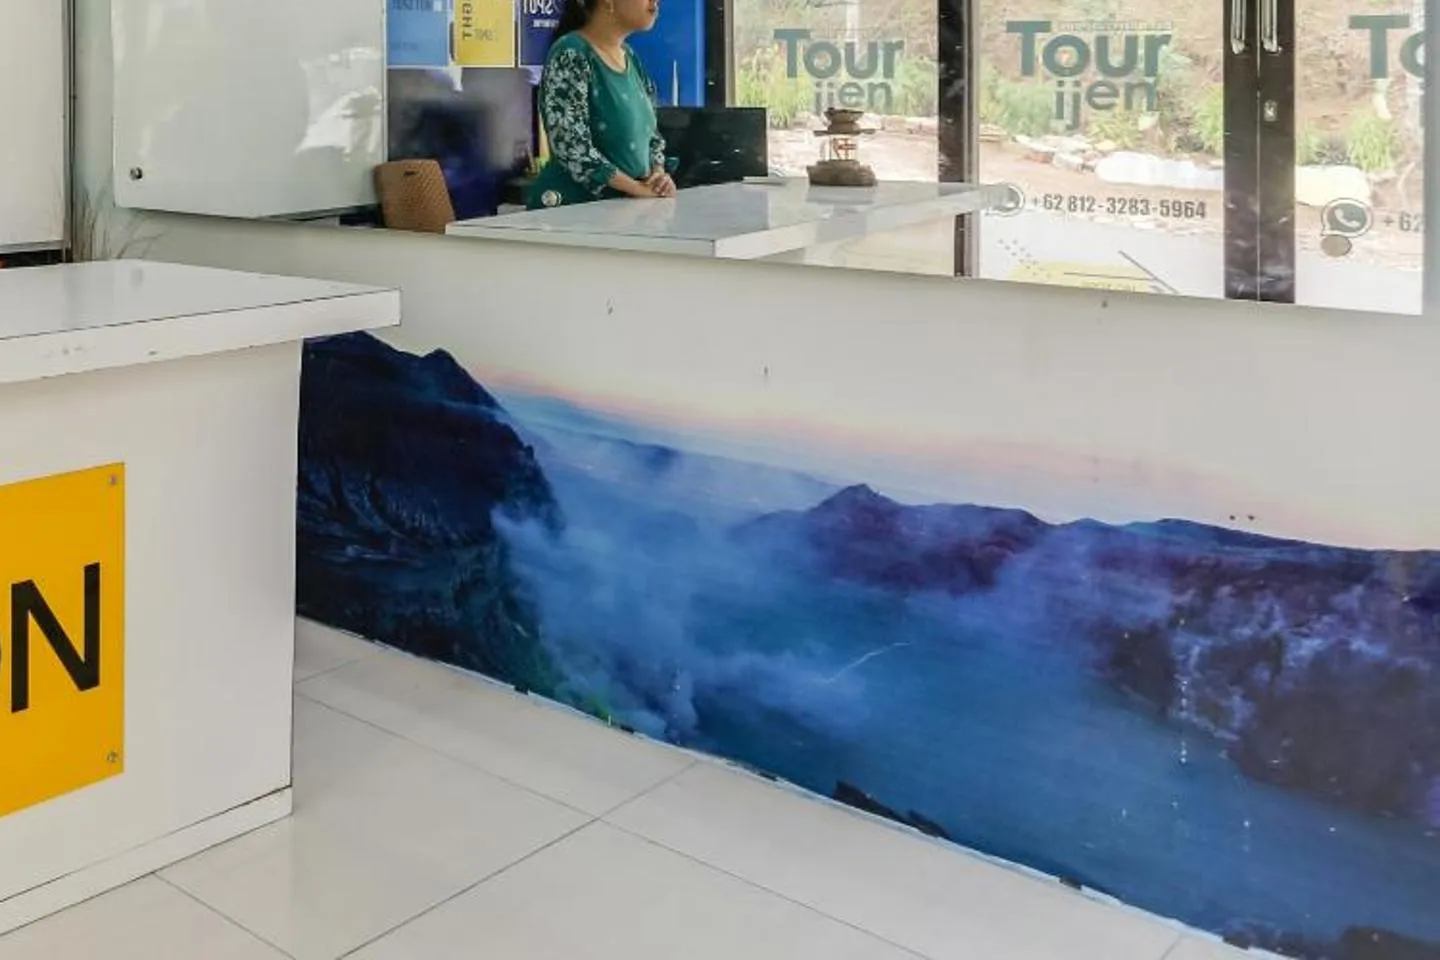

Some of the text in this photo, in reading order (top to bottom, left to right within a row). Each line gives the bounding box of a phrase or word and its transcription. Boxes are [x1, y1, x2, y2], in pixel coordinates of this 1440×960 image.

[773, 28, 905, 80] Tour
[1006, 20, 1172, 78] Tour
[814, 81, 894, 115] ijen
[1055, 80, 1160, 131] ijen
